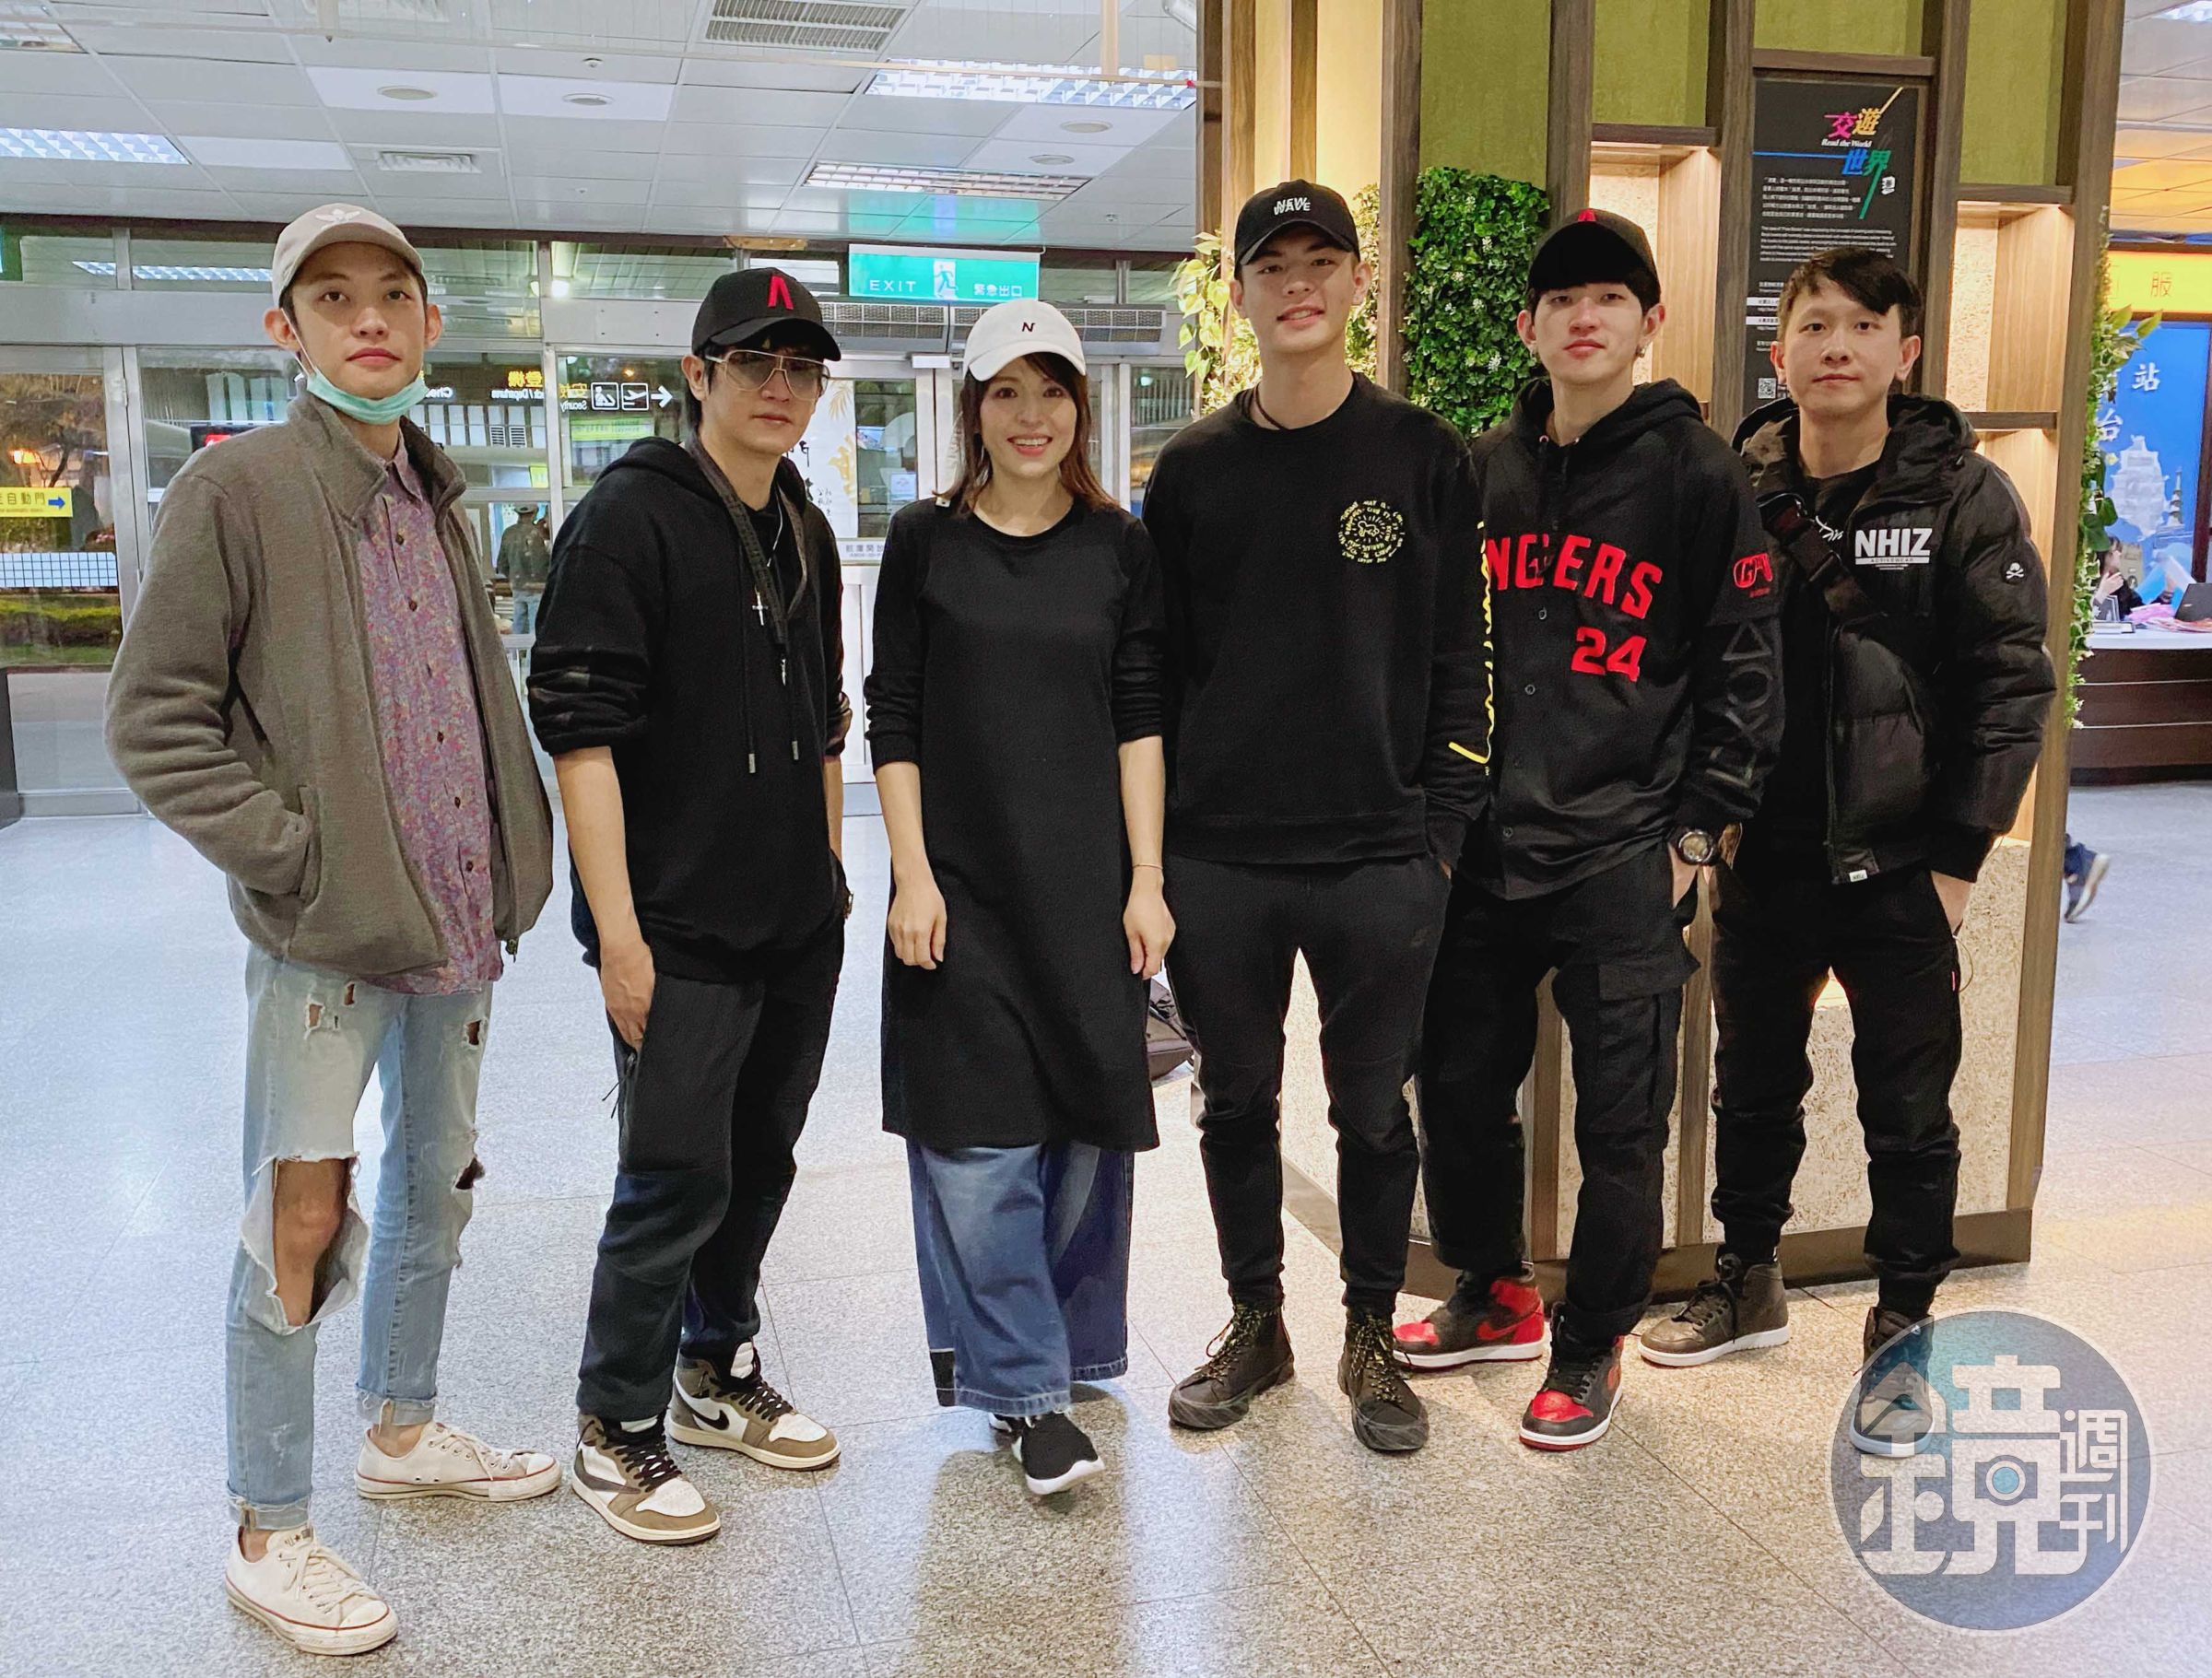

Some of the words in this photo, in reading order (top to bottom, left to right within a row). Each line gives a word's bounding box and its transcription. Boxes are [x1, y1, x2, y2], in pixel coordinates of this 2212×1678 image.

[1852, 139, 1873, 148] World
[1841, 147, 1891, 177] 世界
[869, 279, 917, 293] EXIT
[973, 282, 1023, 298] 緊急出口
[1021, 322, 1036, 333] N
[1854, 528, 1933, 557] NHIZ
[1570, 626, 1647, 683] 24
